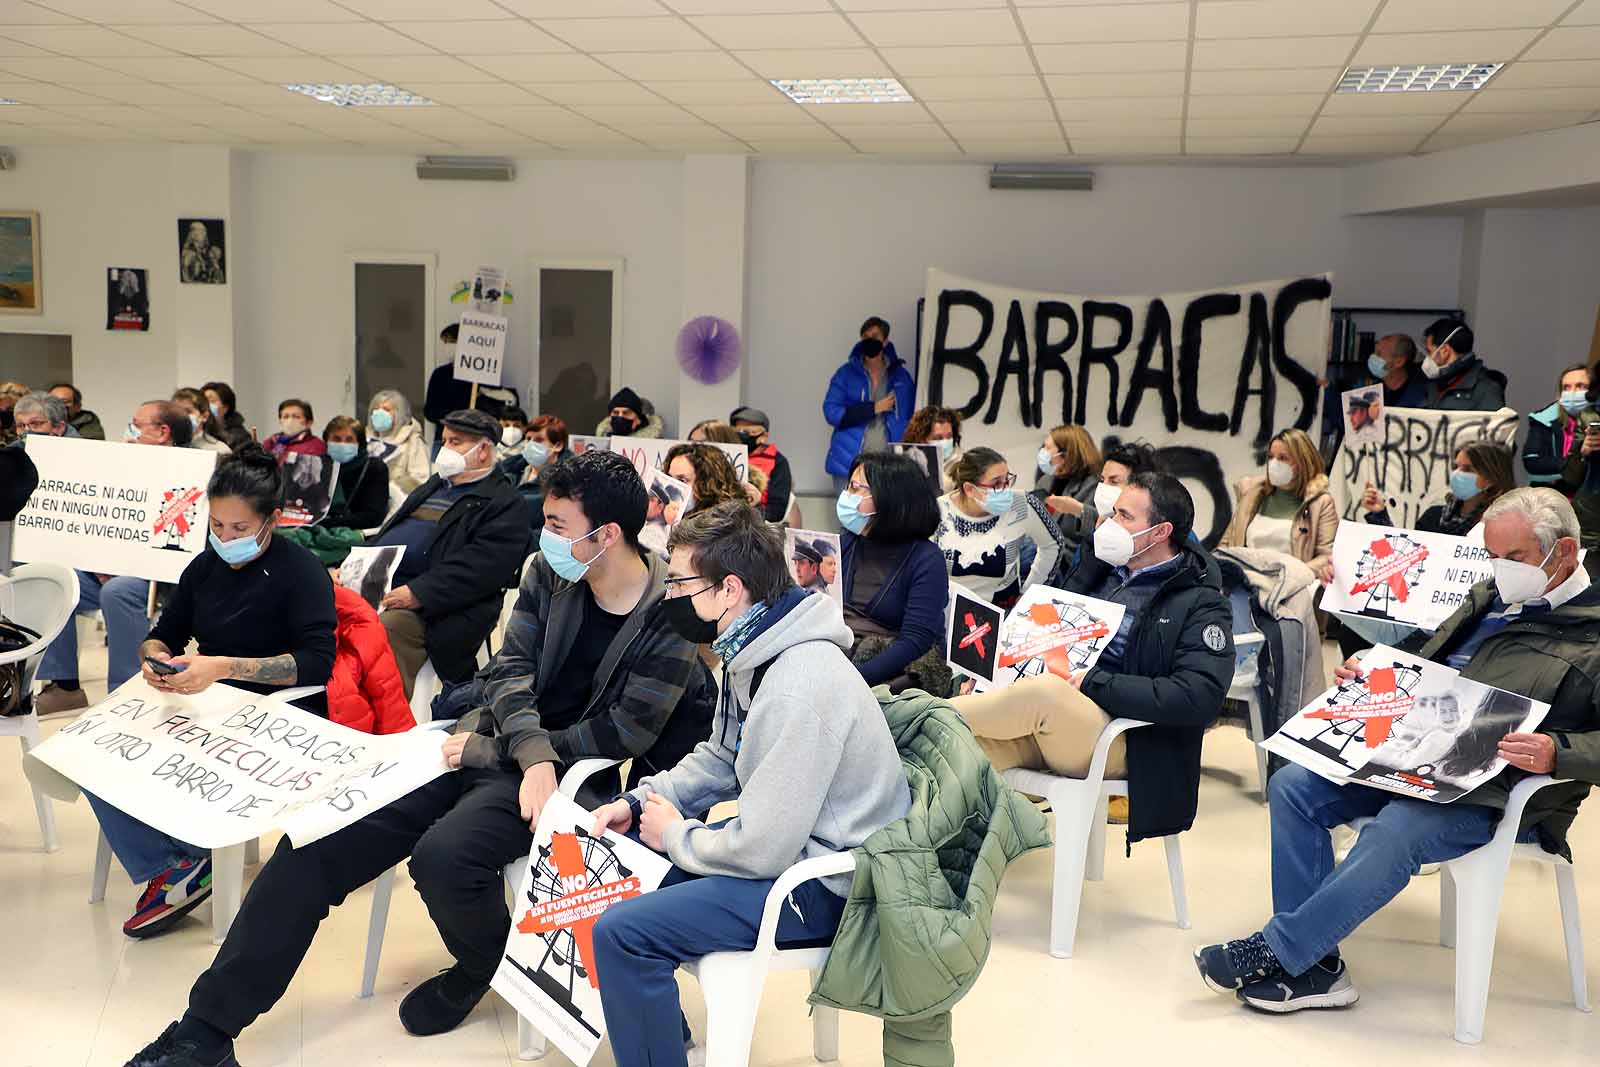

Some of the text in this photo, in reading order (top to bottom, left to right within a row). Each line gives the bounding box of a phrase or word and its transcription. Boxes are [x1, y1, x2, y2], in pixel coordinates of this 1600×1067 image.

[463, 318, 505, 332] BARRACAS
[460, 354, 497, 374] NO!!
[928, 279, 1331, 462] BARRACAS
[102, 486, 115, 499] NI
[27, 497, 39, 509] NI
[42, 498, 59, 511] EN
[112, 507, 146, 522] OTRO
[18, 514, 150, 542] BARRIO de VIVIENDAS
[1445, 568, 1459, 582] NI
[1460, 570, 1477, 584] EN
[1370, 692, 1395, 704] NO
[153, 715, 322, 791] FUENTECILLAS
[94, 732, 153, 761] OTRO
[152, 753, 233, 801] BARRIO
[227, 794, 272, 817] DE
[561, 873, 587, 896] NO
[530, 881, 634, 917] EN FUENTECILLAS
